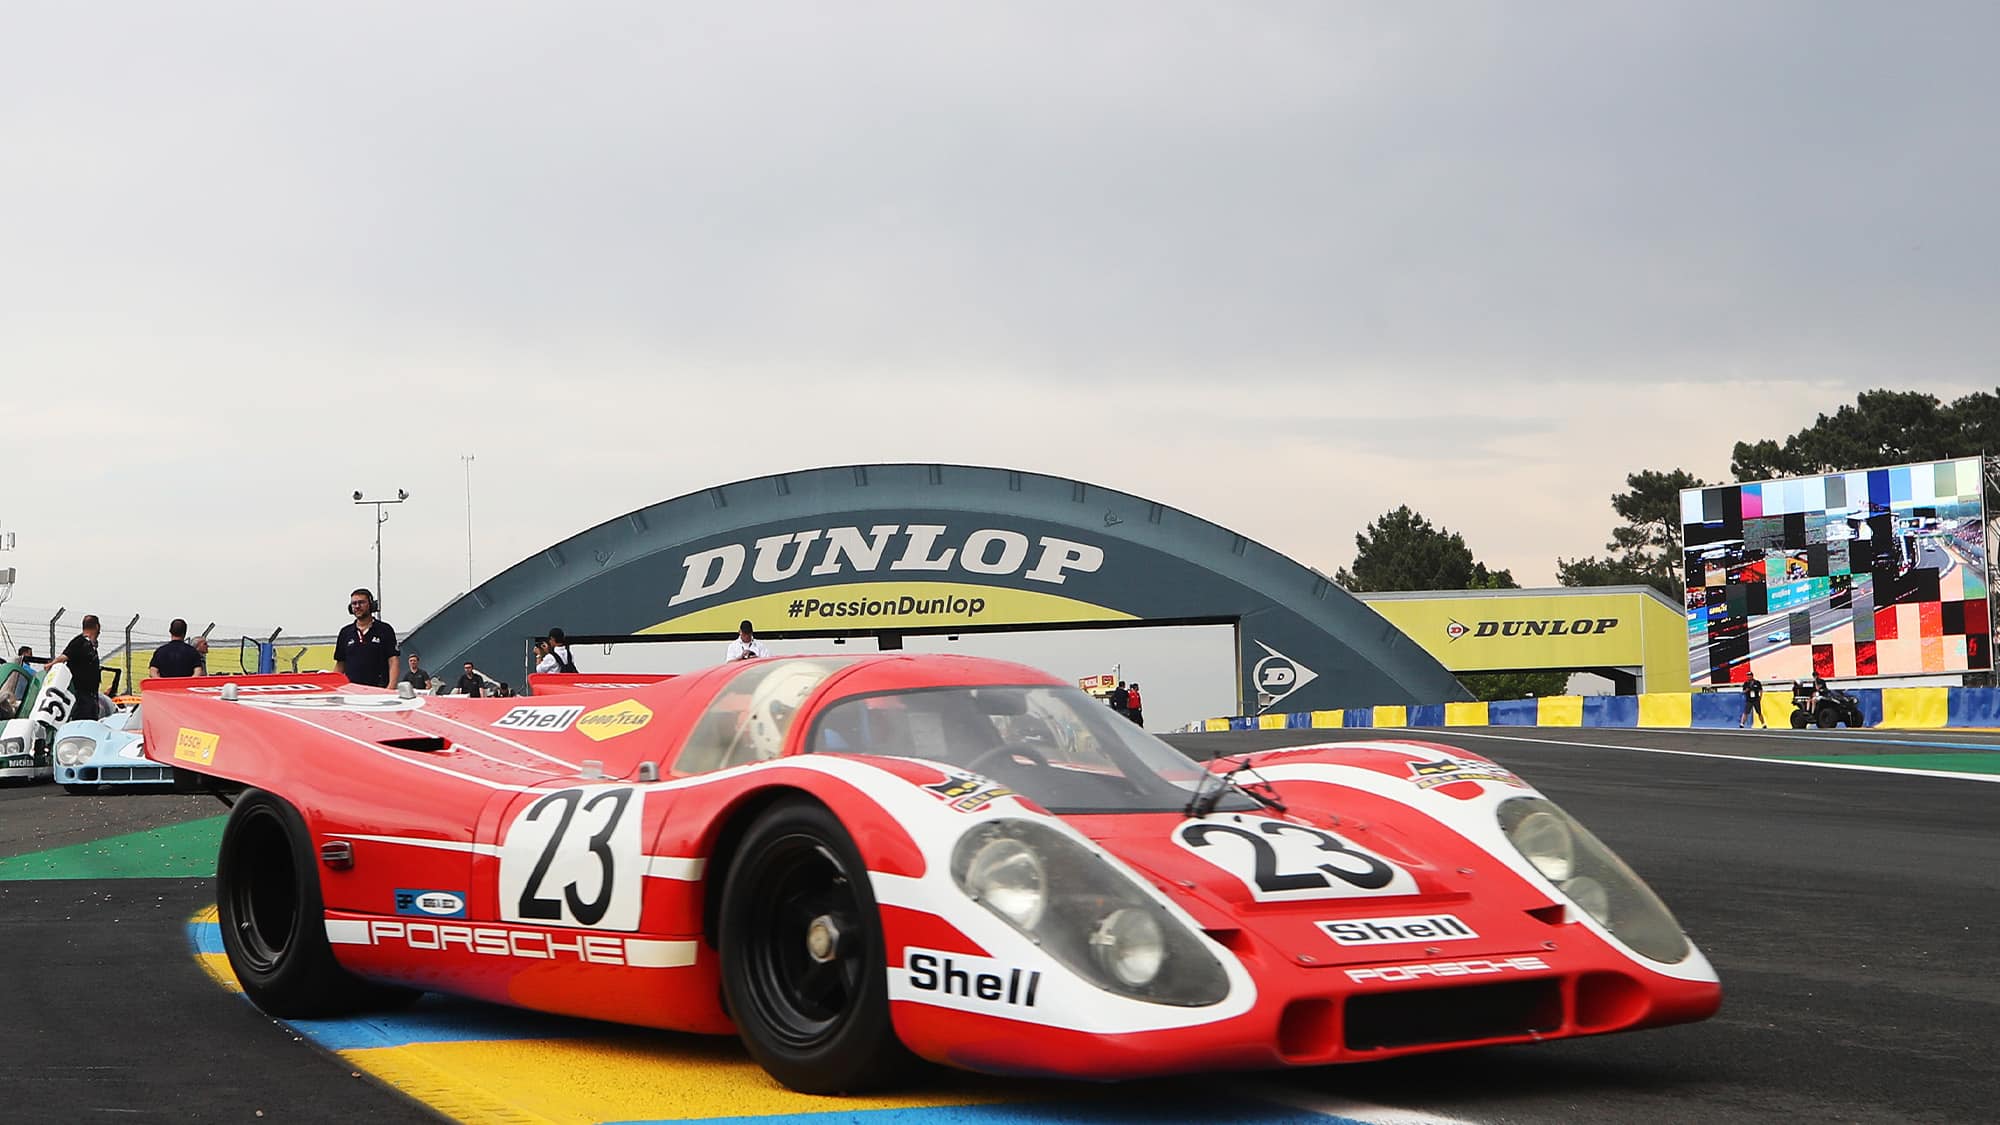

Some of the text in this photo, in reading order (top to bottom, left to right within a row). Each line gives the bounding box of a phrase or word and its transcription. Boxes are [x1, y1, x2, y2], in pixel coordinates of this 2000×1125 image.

[667, 525, 1105, 607] DUNLOP
[788, 594, 986, 618] #PassionDunlop
[1474, 618, 1619, 638] DUNLOP
[500, 709, 578, 729] Shell
[519, 787, 634, 926] 23
[1182, 821, 1394, 893] 23
[371, 920, 625, 965] PORSCHE
[1328, 918, 1471, 942] Shell
[909, 953, 1042, 1007] Shell
[1344, 956, 1552, 984] PORSCHE
